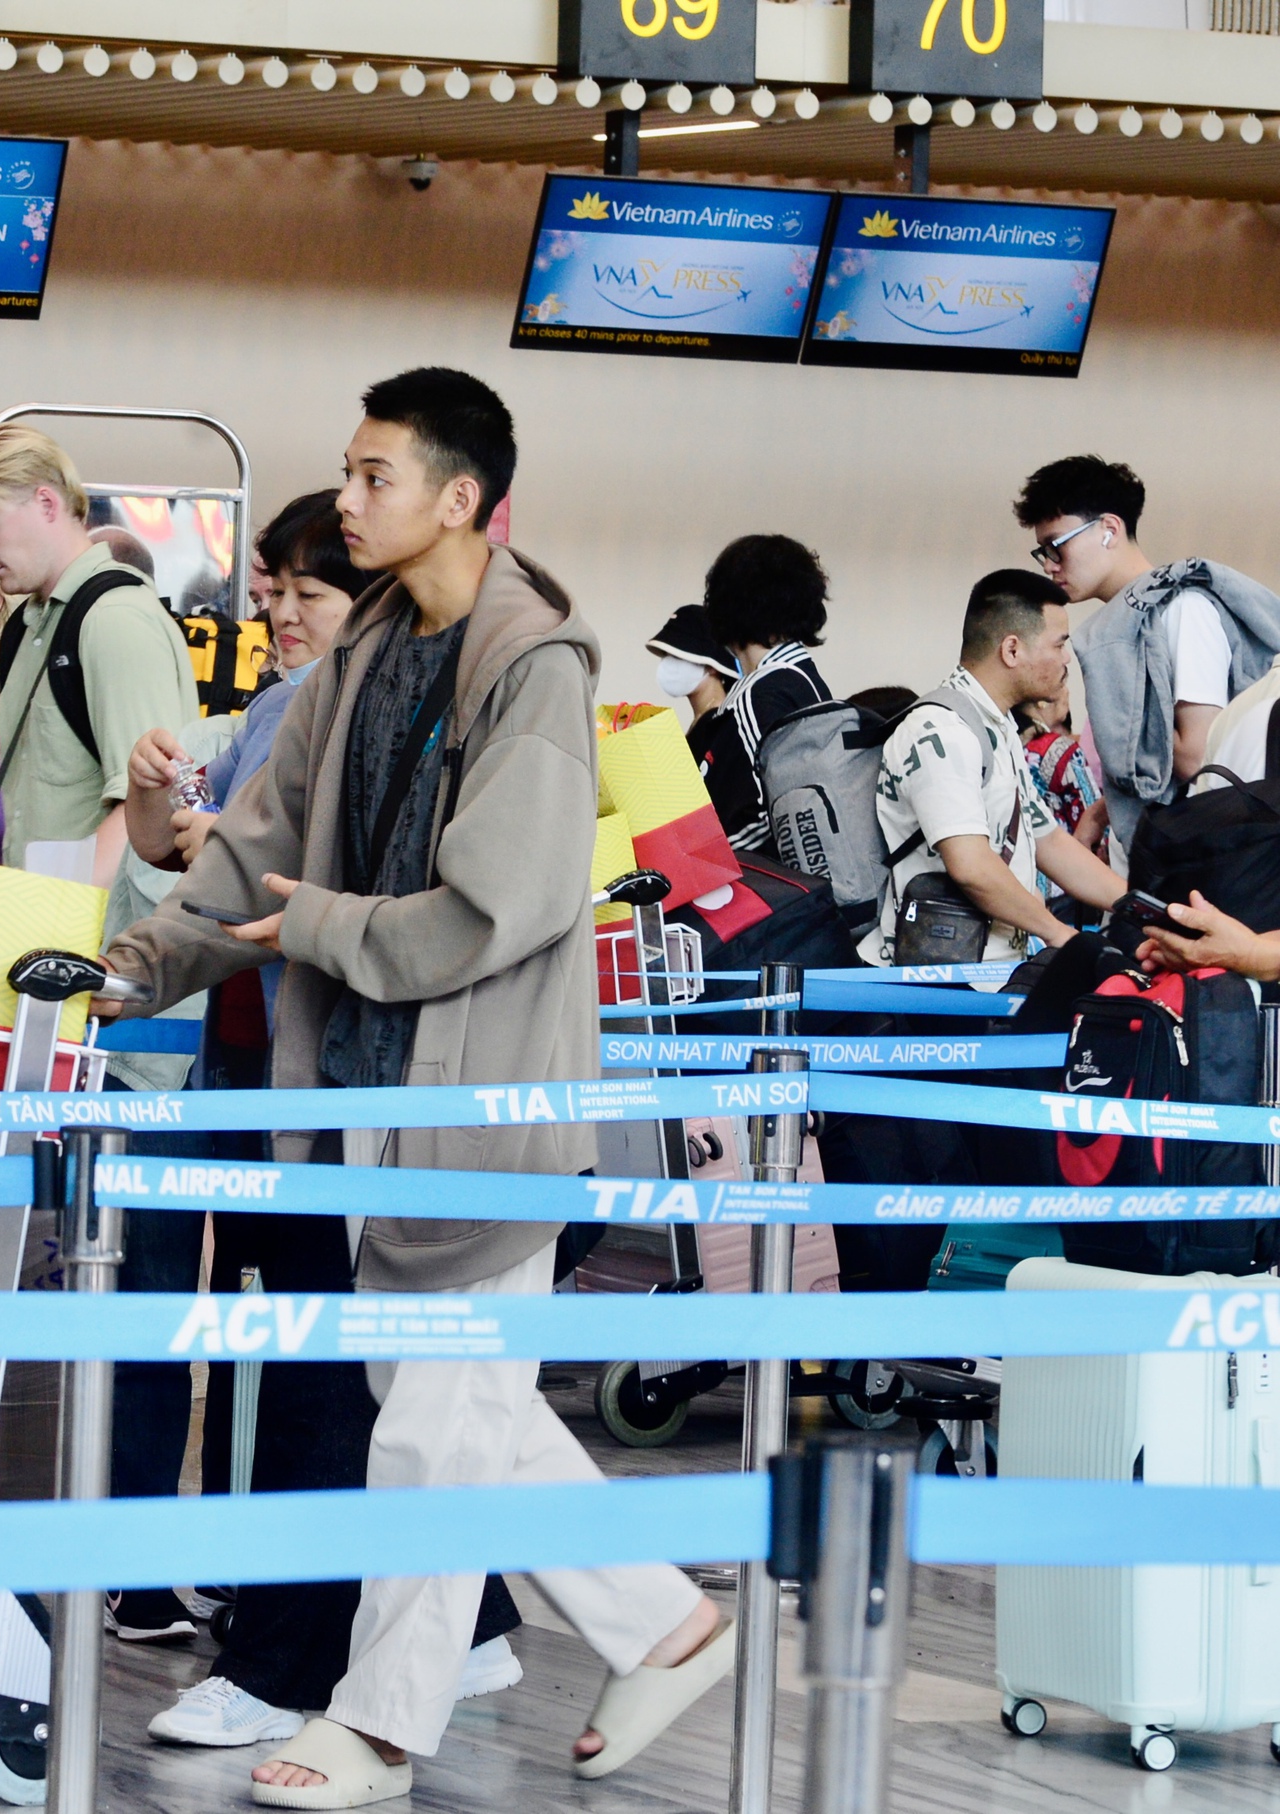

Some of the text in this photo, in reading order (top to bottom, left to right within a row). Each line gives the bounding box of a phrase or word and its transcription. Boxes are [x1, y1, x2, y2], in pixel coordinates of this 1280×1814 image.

[538, 328, 571, 339] closes
[574, 330, 587, 340] 40
[590, 331, 614, 341] mins
[617, 332, 640, 344] prior
[643, 333, 653, 343] to
[776, 813, 800, 871] SHION
[795, 808, 832, 882] NSIDER
[902, 965, 955, 981] ACV
[606, 1041, 654, 1060] SON
[658, 1041, 716, 1061] NHAT
[889, 1042, 981, 1063] AIRPORT
[579, 1082, 653, 1093] TAN SON NHAT
[580, 1095, 659, 1107] INTERNATIONAL
[712, 1083, 761, 1108] TAN
[7, 1092, 55, 1123] TÂN
[63, 1095, 112, 1123] SƠN
[119, 1089, 183, 1124] NHẤT
[474, 1087, 558, 1123] TIA
[582, 1109, 624, 1119] AIRPORT
[1041, 1095, 1136, 1134] TIA
[159, 1165, 281, 1199] AIRPORT
[729, 1185, 751, 1195] TAN
[754, 1186, 777, 1196] SON
[587, 1180, 700, 1219] TIA
[875, 1188, 944, 1218] CẢNG
[950, 1192, 1020, 1218] HÀNG
[1026, 1191, 1113, 1217] KHÔNG
[1118, 1189, 1187, 1217] QUỐC
[1196, 1188, 1232, 1216] TẾ
[170, 1296, 324, 1353] ACV
